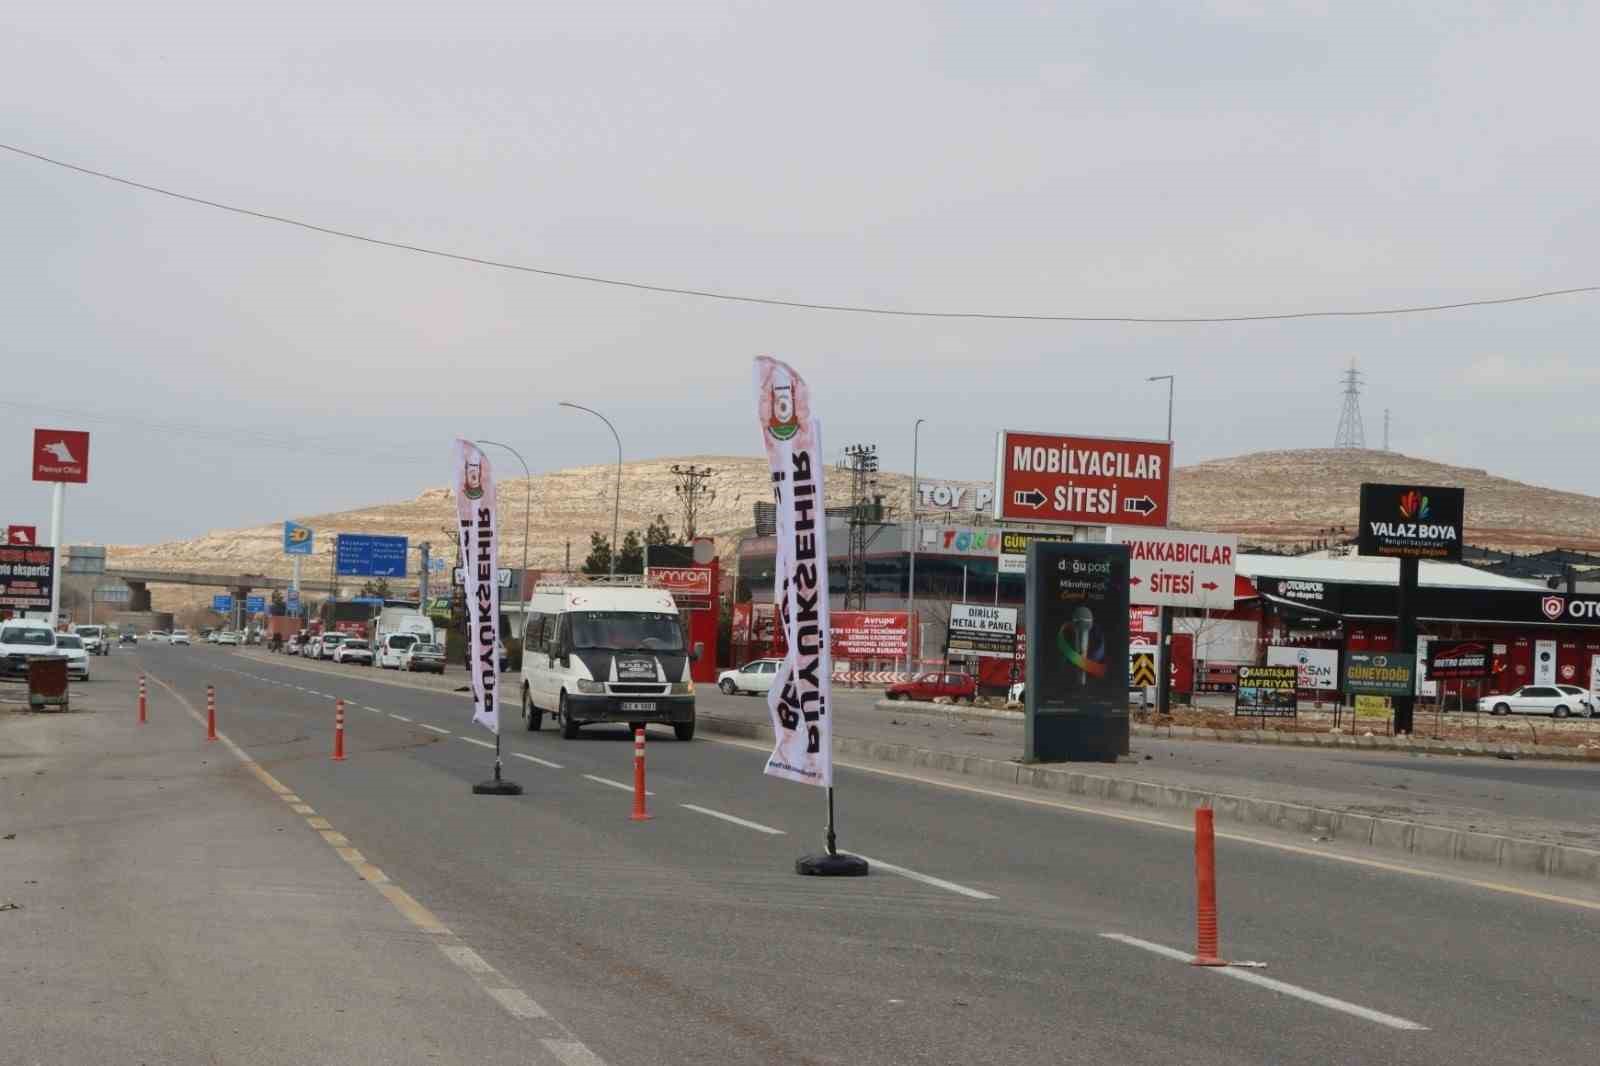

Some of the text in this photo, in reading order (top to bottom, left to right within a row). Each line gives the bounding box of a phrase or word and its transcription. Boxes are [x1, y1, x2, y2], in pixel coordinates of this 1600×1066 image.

[1013, 444, 1161, 480] MOBİLYACILAR
[919, 484, 992, 511] TOY P
[1054, 481, 1117, 514] SİTESİ
[1370, 521, 1457, 540] YALAZ BOYA
[1122, 540, 1231, 565] YAKKABICILAR
[1150, 568, 1194, 594] SİTESİ
[1568, 600, 1600, 617] OT
[952, 618, 977, 629] METAL
[988, 620, 1013, 632] PANEL
[1239, 678, 1297, 689] HAFRİYAT
